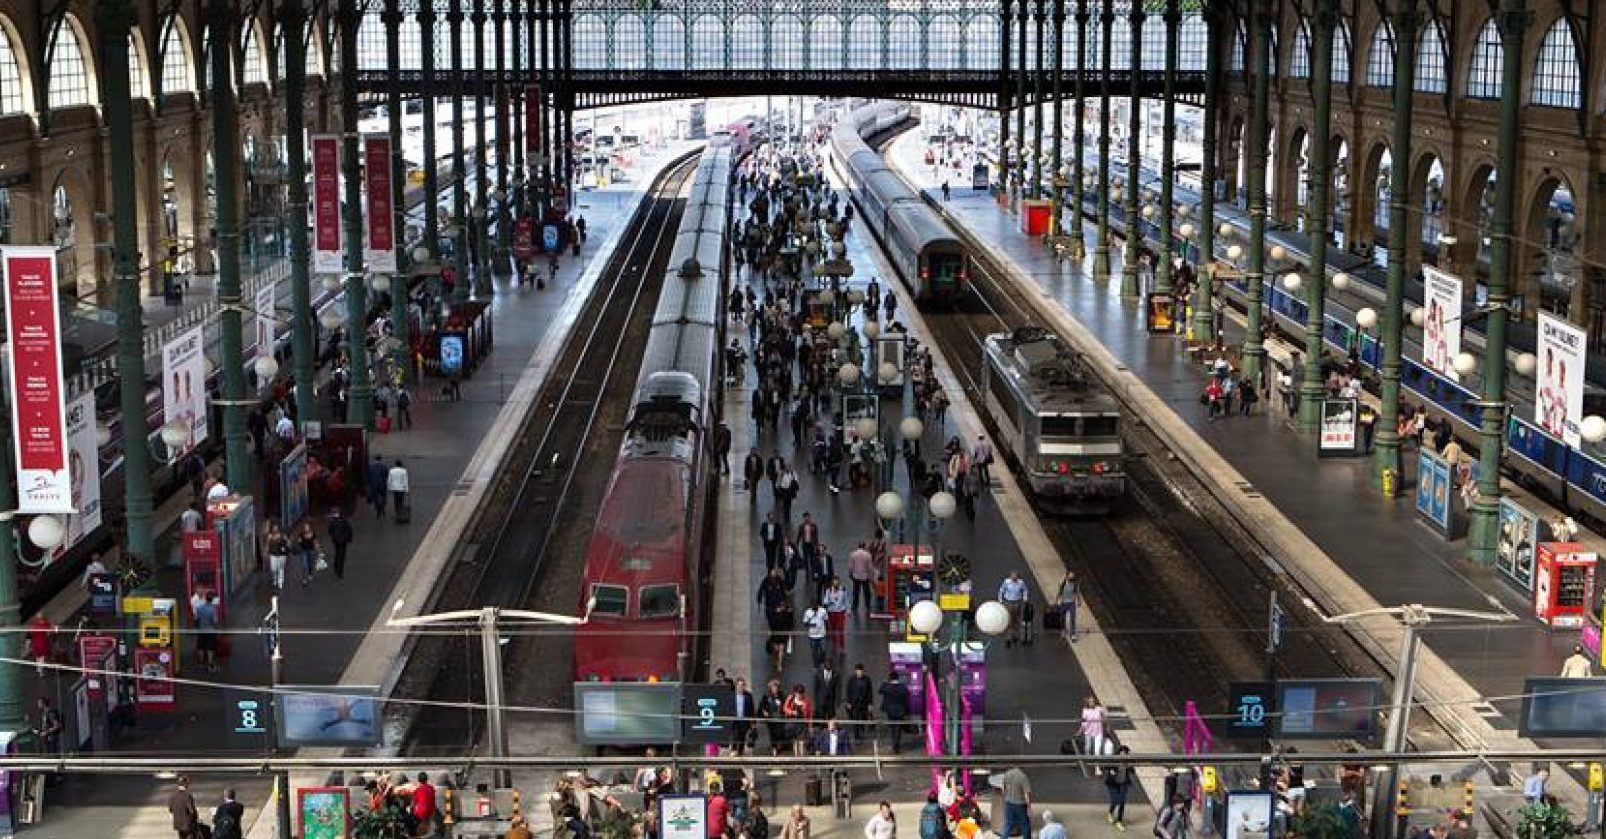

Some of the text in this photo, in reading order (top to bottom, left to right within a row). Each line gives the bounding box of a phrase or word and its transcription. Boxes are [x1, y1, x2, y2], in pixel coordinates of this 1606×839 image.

[242, 710, 256, 728] 8
[700, 708, 715, 726] 9
[1237, 704, 1265, 722] 10
